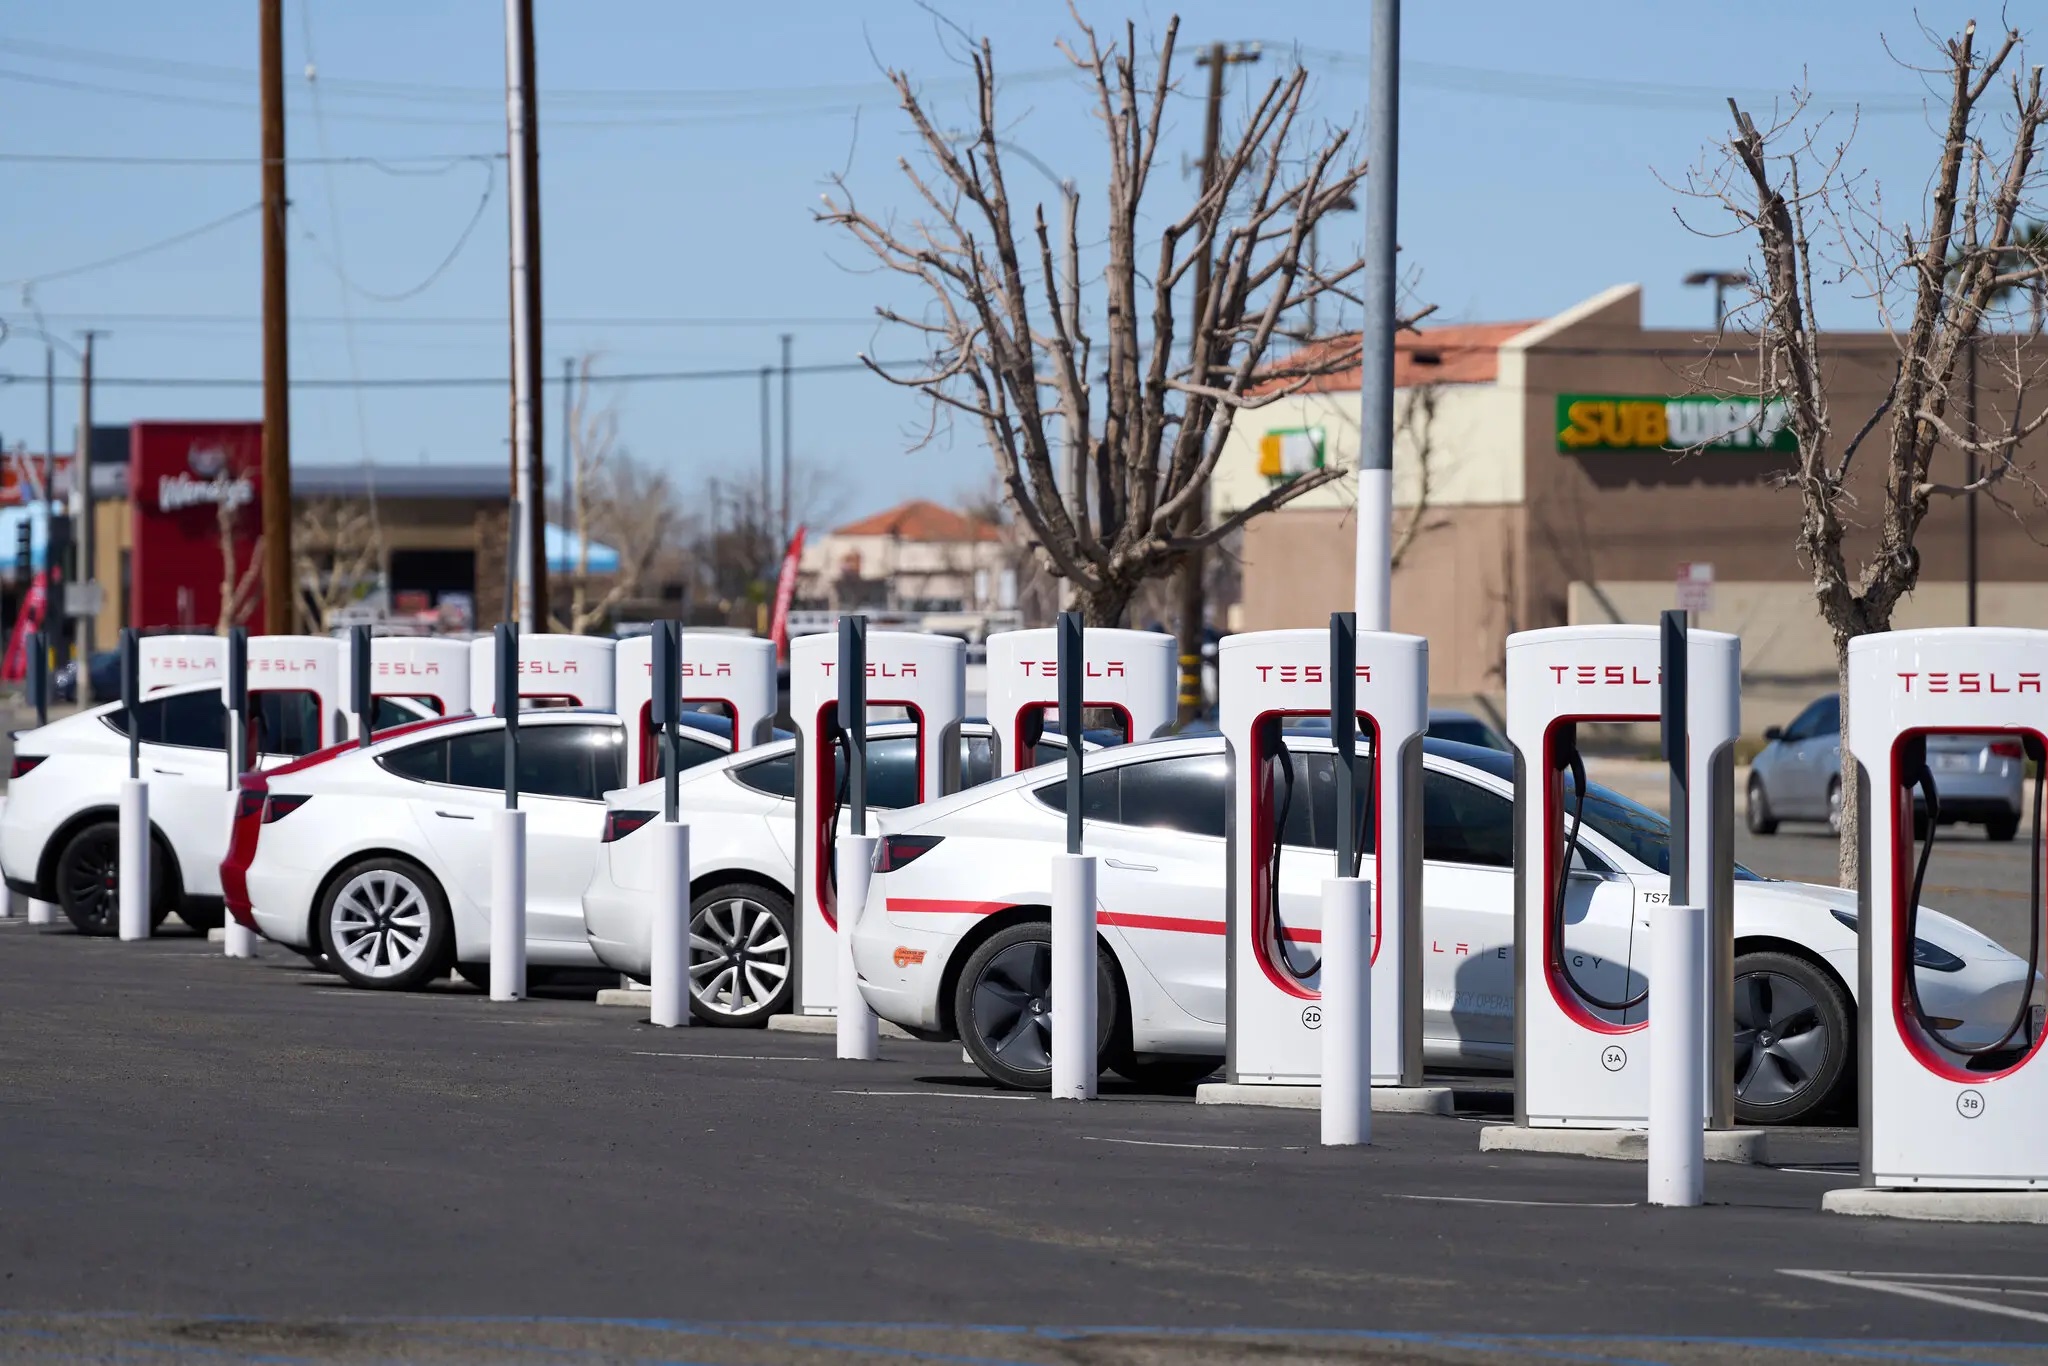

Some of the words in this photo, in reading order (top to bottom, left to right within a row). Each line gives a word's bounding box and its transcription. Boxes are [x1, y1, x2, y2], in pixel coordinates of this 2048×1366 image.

[1560, 400, 1788, 447] SUBWAY
[150, 657, 216, 670] TESLA
[378, 662, 439, 675] ESLA
[644, 663, 731, 676] TSLA
[821, 662, 917, 677] TSLA
[1019, 661, 1124, 677] TELA
[1255, 666, 1371, 682] TESA
[1549, 666, 1662, 684] TESL
[1896, 672, 2041, 693] TESLA
[1643, 892, 1670, 904] TS7
[1305, 1012, 1321, 1022] 2D
[1607, 1054, 1622, 1062] 3A
[1963, 1098, 1978, 1109] 3B
